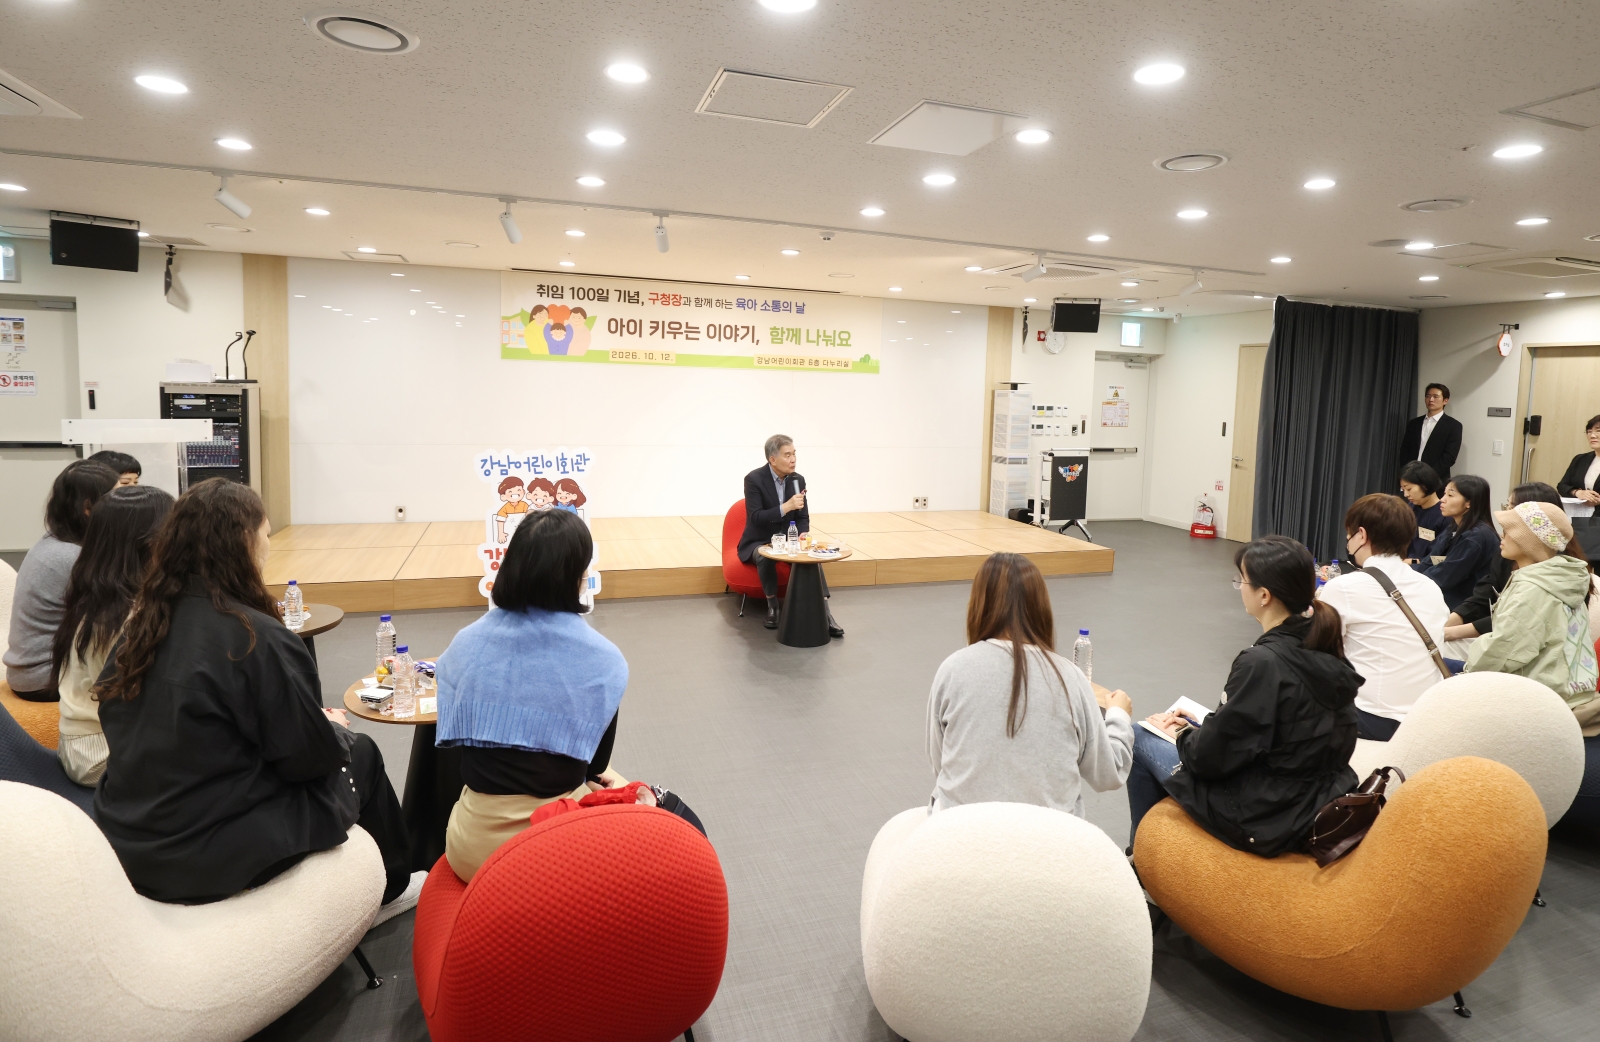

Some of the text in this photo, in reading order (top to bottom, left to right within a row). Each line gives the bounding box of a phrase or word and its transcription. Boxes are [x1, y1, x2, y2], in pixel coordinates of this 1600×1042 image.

[536, 284, 806, 315] 취임 100일 기념, 구청장과 함께 하는 육아 소통의 날
[607, 317, 852, 348] 아이 키우는 이야기, 함께 나눠요
[611, 350, 641, 360] 2026.
[644, 352, 657, 361] 10.
[756, 356, 805, 366] 강남어린이회관
[822, 359, 849, 368] 다누리실
[480, 452, 591, 477] 강남어린이회관
